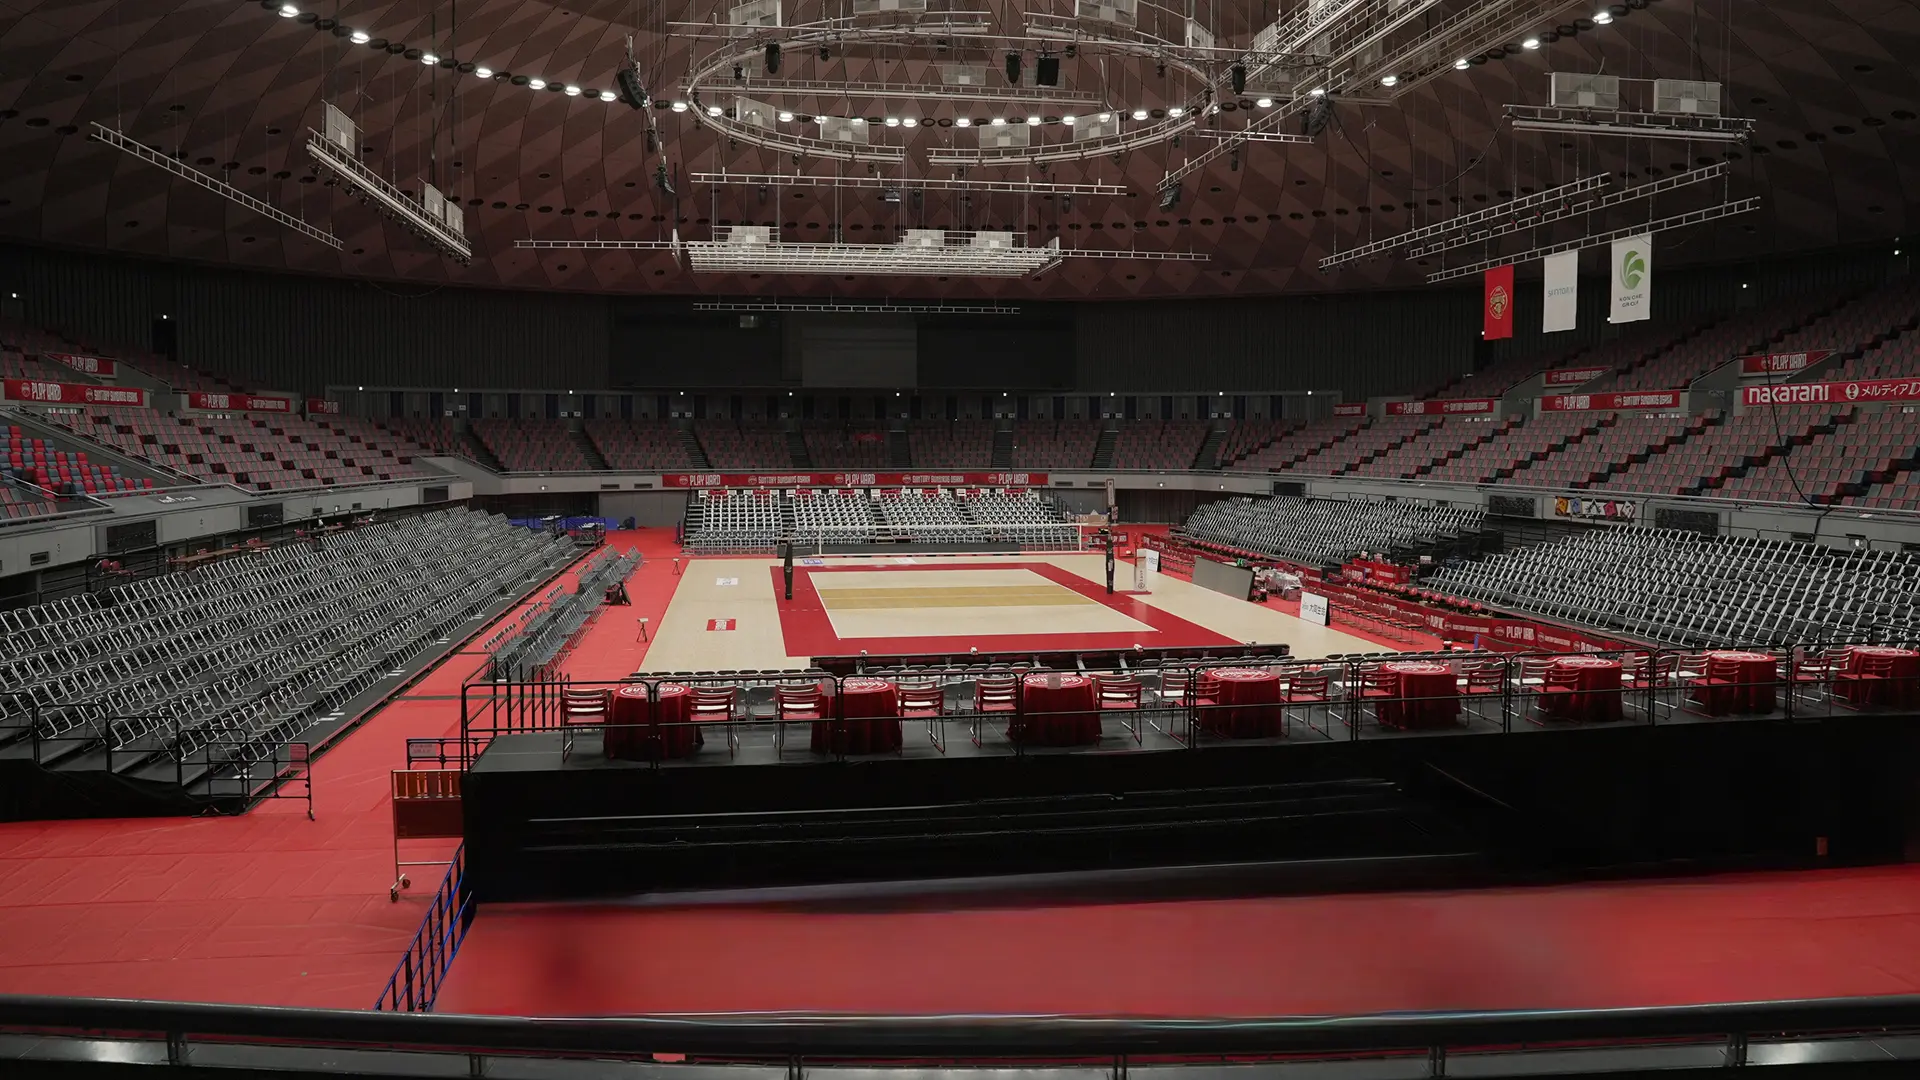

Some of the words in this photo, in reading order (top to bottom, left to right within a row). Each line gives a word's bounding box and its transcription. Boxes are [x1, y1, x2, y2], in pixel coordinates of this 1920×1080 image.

[1771, 354, 1789, 370] PLAY
[1563, 396, 1577, 410] PLAY
[689, 474, 705, 486] PLAY
[705, 474, 721, 486] HARD
[845, 473, 860, 485] PLAY
[860, 473, 876, 485] HARD
[998, 473, 1013, 485] PLAY
[1013, 473, 1029, 485] HARD
[1506, 626, 1523, 639] PLAY
